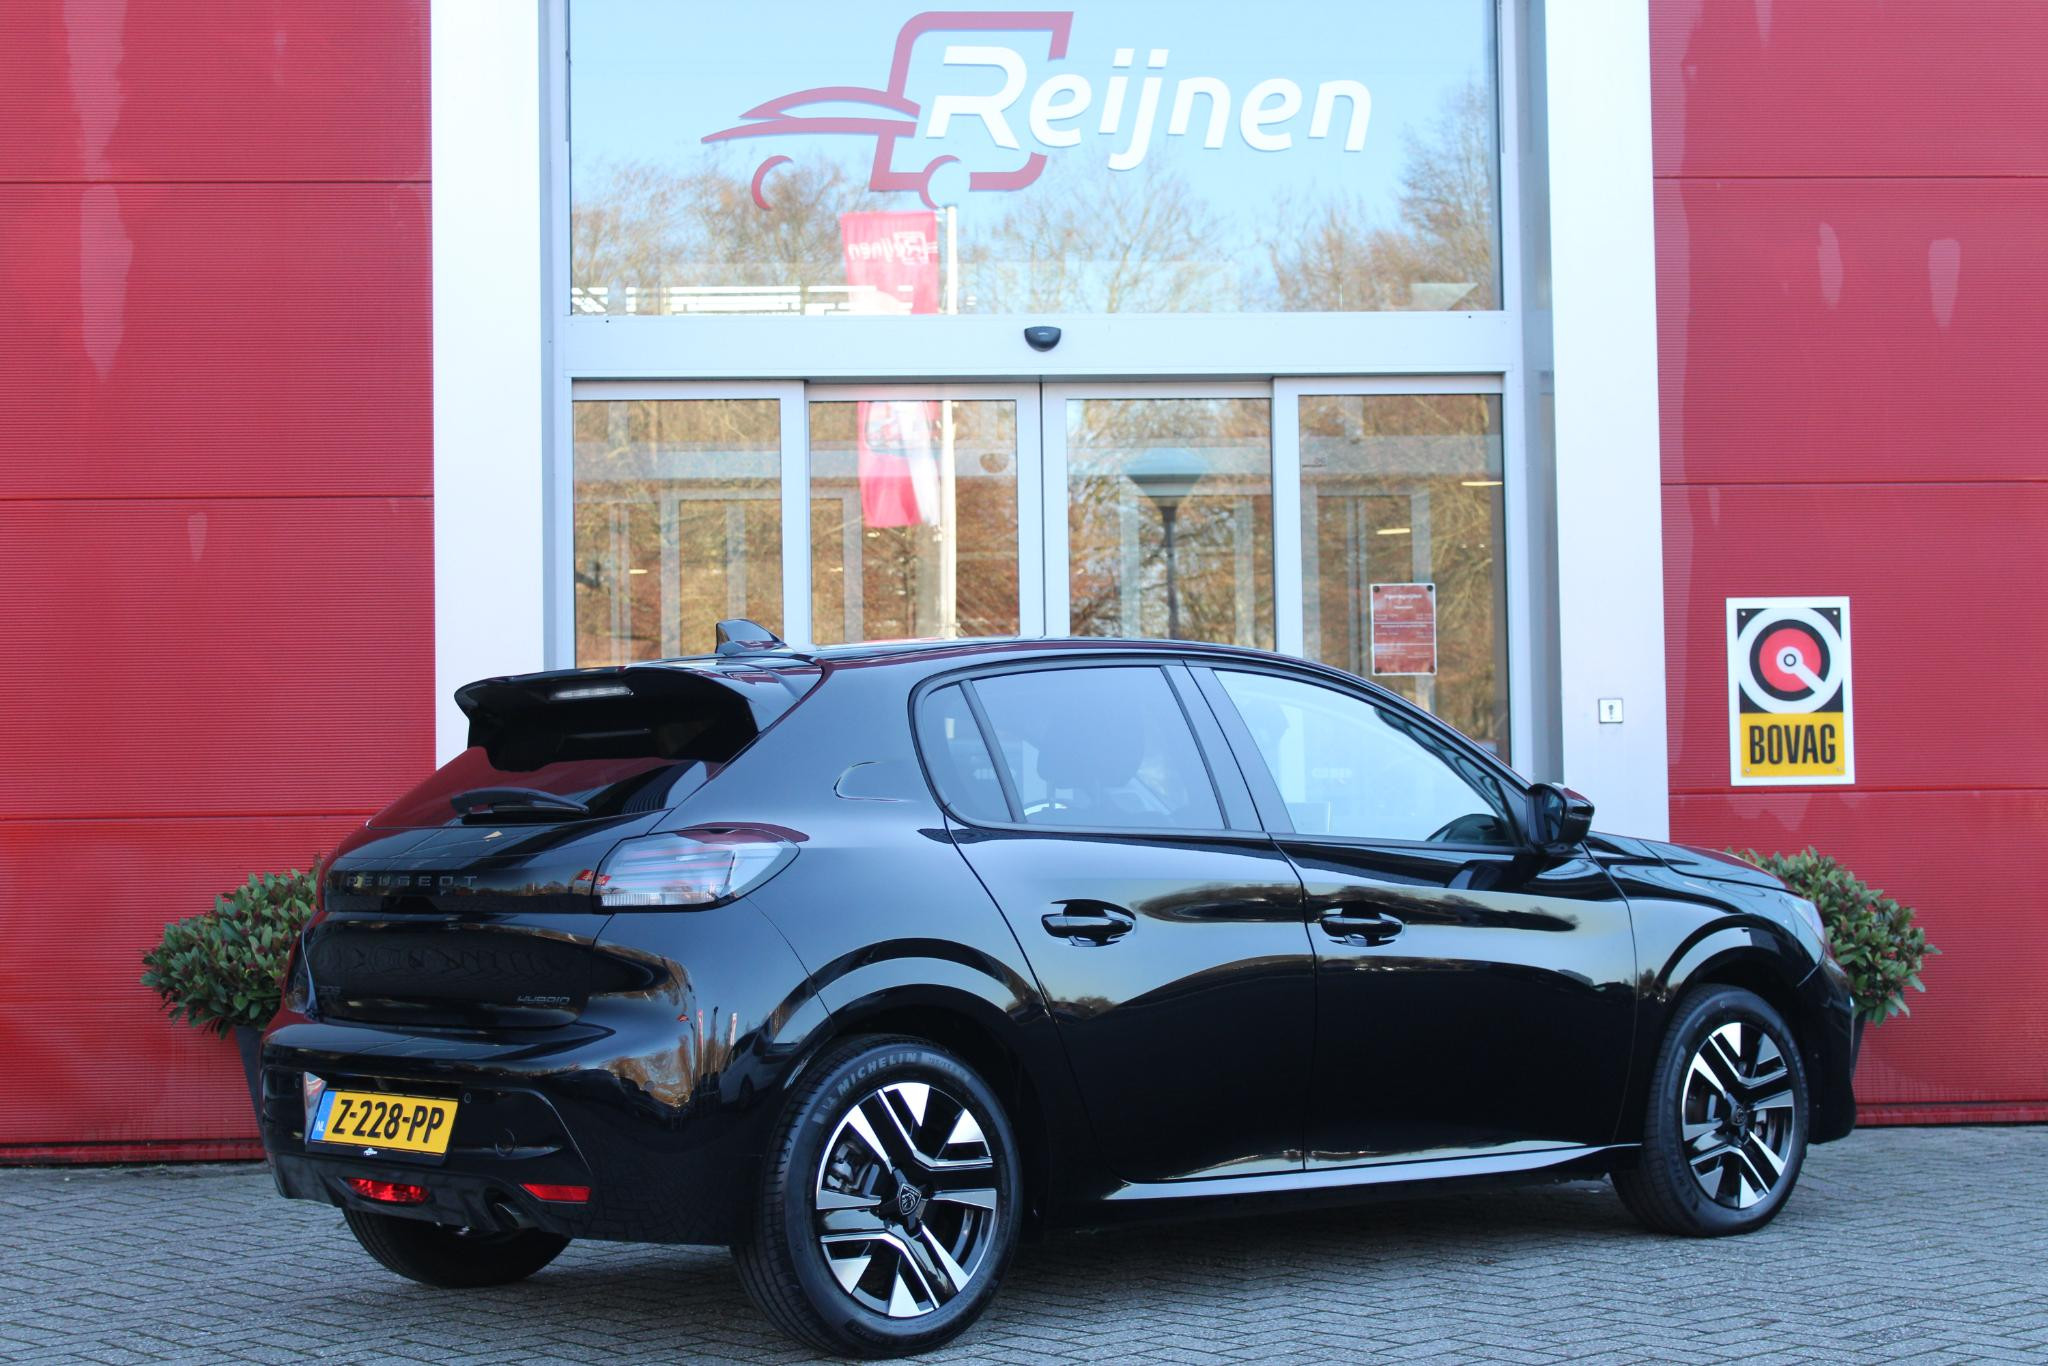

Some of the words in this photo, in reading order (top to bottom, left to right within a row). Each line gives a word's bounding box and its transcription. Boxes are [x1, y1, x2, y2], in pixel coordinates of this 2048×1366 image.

[925, 45, 1373, 171] Reijnen
[1749, 724, 1836, 765] BOVAG
[346, 875, 478, 887] PEUGEOT
[837, 1052, 917, 1096] MICHELIN
[315, 1120, 325, 1132] NL
[332, 1099, 444, 1143] Z-228-PP
